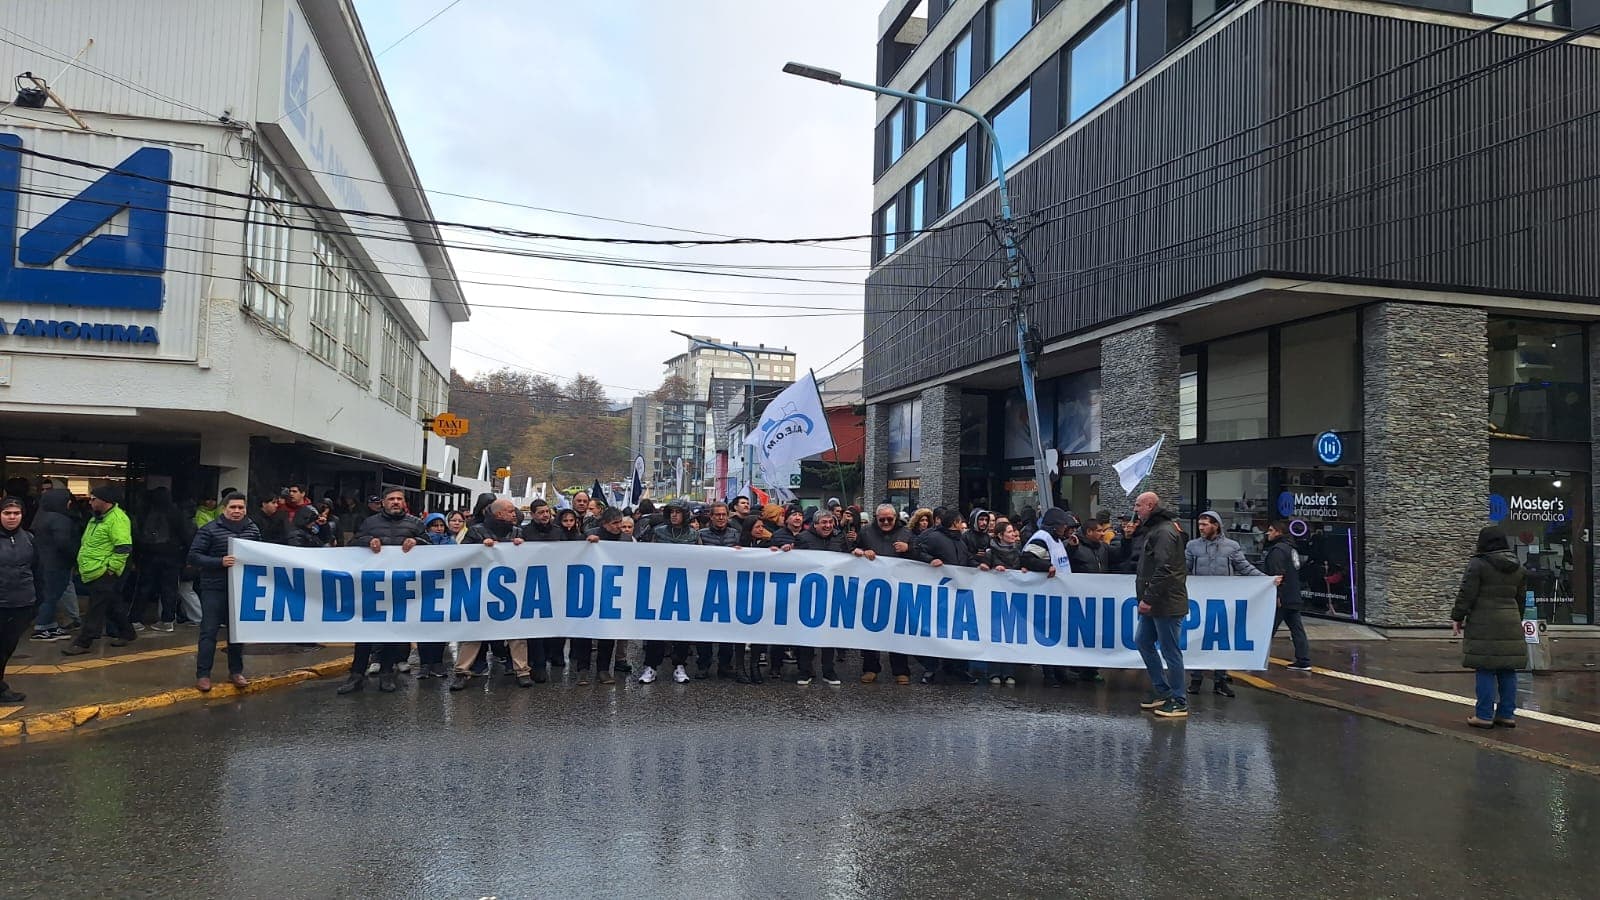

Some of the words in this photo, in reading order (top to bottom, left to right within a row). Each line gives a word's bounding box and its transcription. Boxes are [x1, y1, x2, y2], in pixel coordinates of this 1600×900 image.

[13, 318, 160, 344] ANONIMA
[439, 420, 463, 429] TAXI
[1295, 492, 1338, 506] Master's
[1510, 496, 1564, 510] Master's
[1294, 506, 1338, 517] Informática
[1510, 510, 1565, 521] Informática
[240, 564, 306, 622] EN
[321, 565, 553, 622] DEFENSA
[565, 564, 624, 619] DE
[635, 566, 691, 622] LA
[700, 569, 980, 642] AUTONOMÍA
[991, 590, 1254, 651] MUNICPAL
